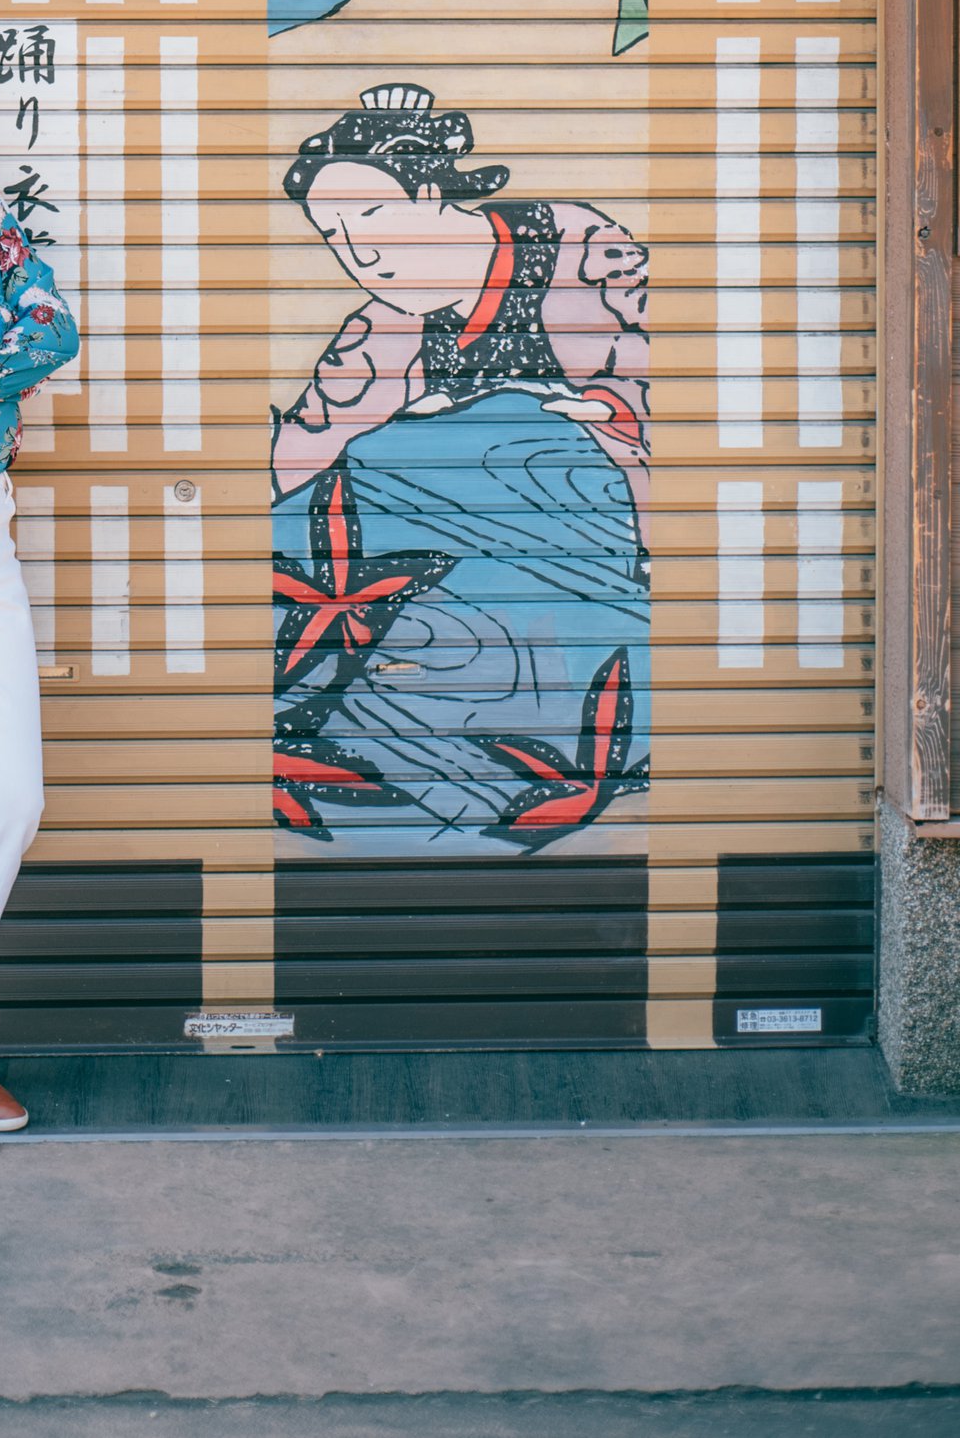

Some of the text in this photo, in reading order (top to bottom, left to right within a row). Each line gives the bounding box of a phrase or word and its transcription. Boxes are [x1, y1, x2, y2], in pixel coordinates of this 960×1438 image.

[188, 1022, 243, 1033] 文化シャッター
